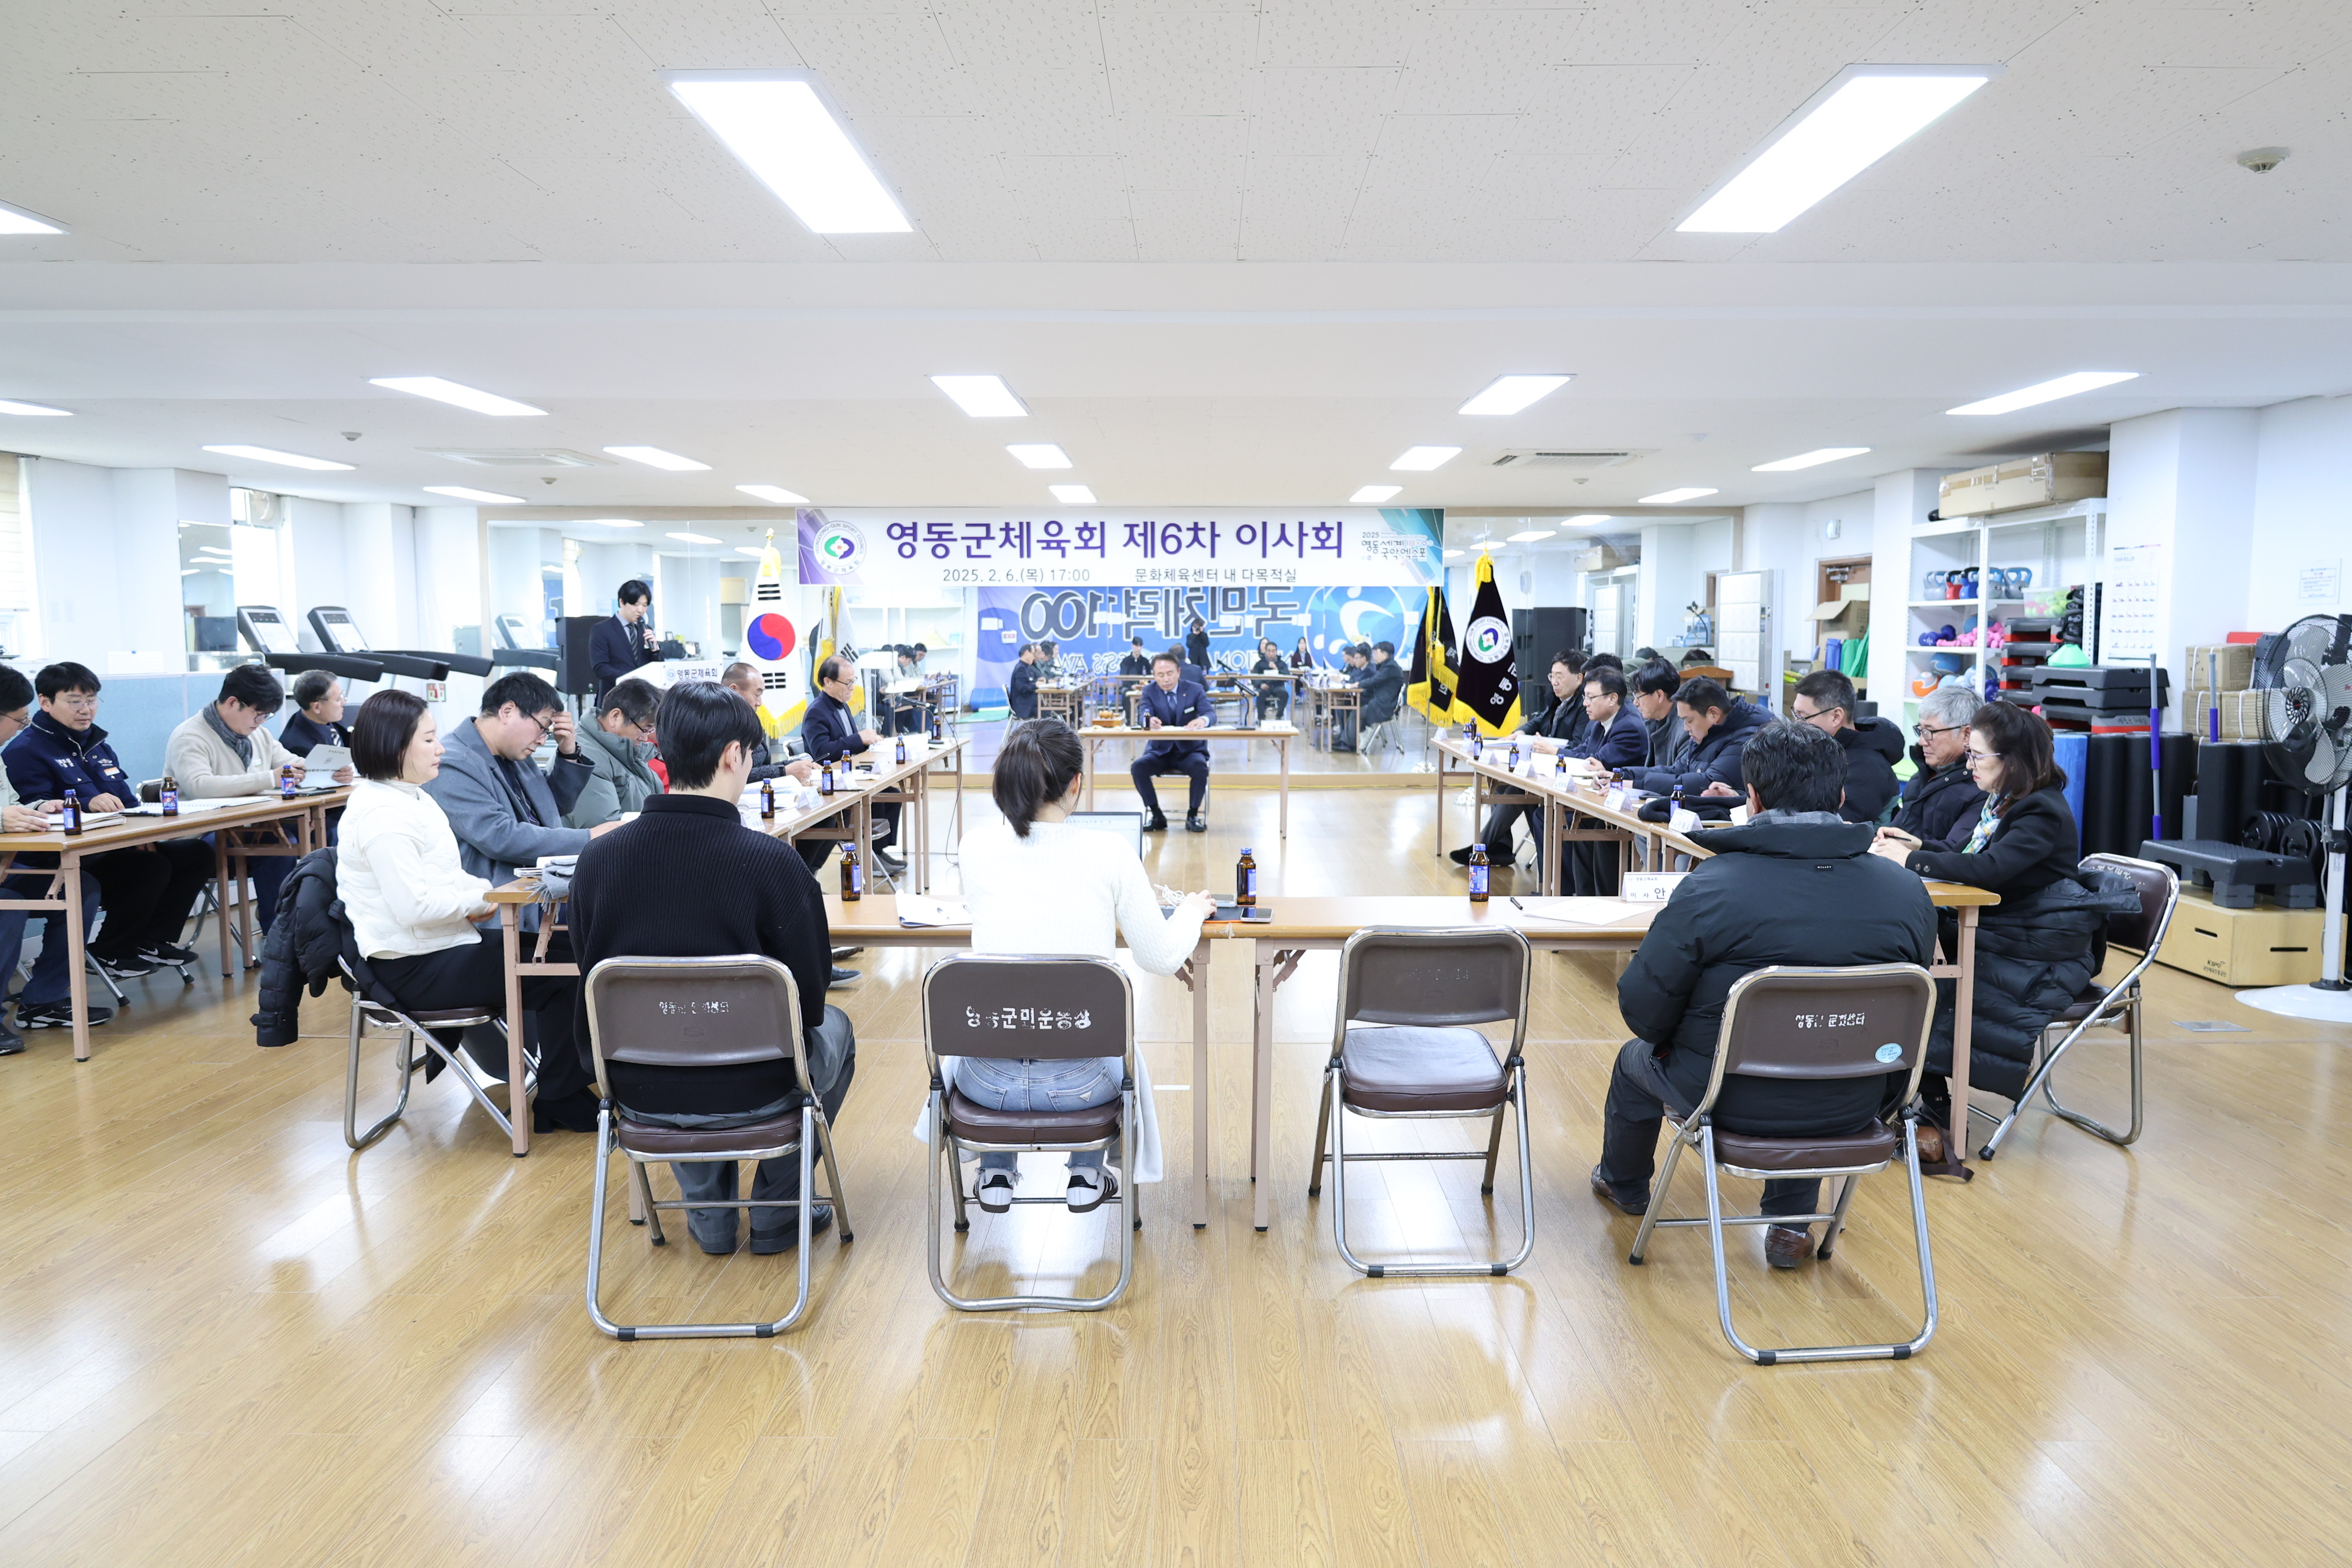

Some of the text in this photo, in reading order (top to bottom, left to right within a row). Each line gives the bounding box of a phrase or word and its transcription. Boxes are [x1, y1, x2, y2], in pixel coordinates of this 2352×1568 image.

[842, 523, 858, 534] SPORT
[856, 534, 865, 554] COUNCIL
[887, 520, 1342, 559] 영동군체육회 제6차 이사회
[1361, 540, 1379, 554] 영동
[1381, 547, 1426, 560] 국악엑스포
[943, 568, 1297, 583] 2025. 2. 6.(목) 17:00 문화체육센터 내 다목적실
[1474, 618, 1504, 630] SPORT COUNCIL
[677, 668, 718, 680] 영동군체육회
